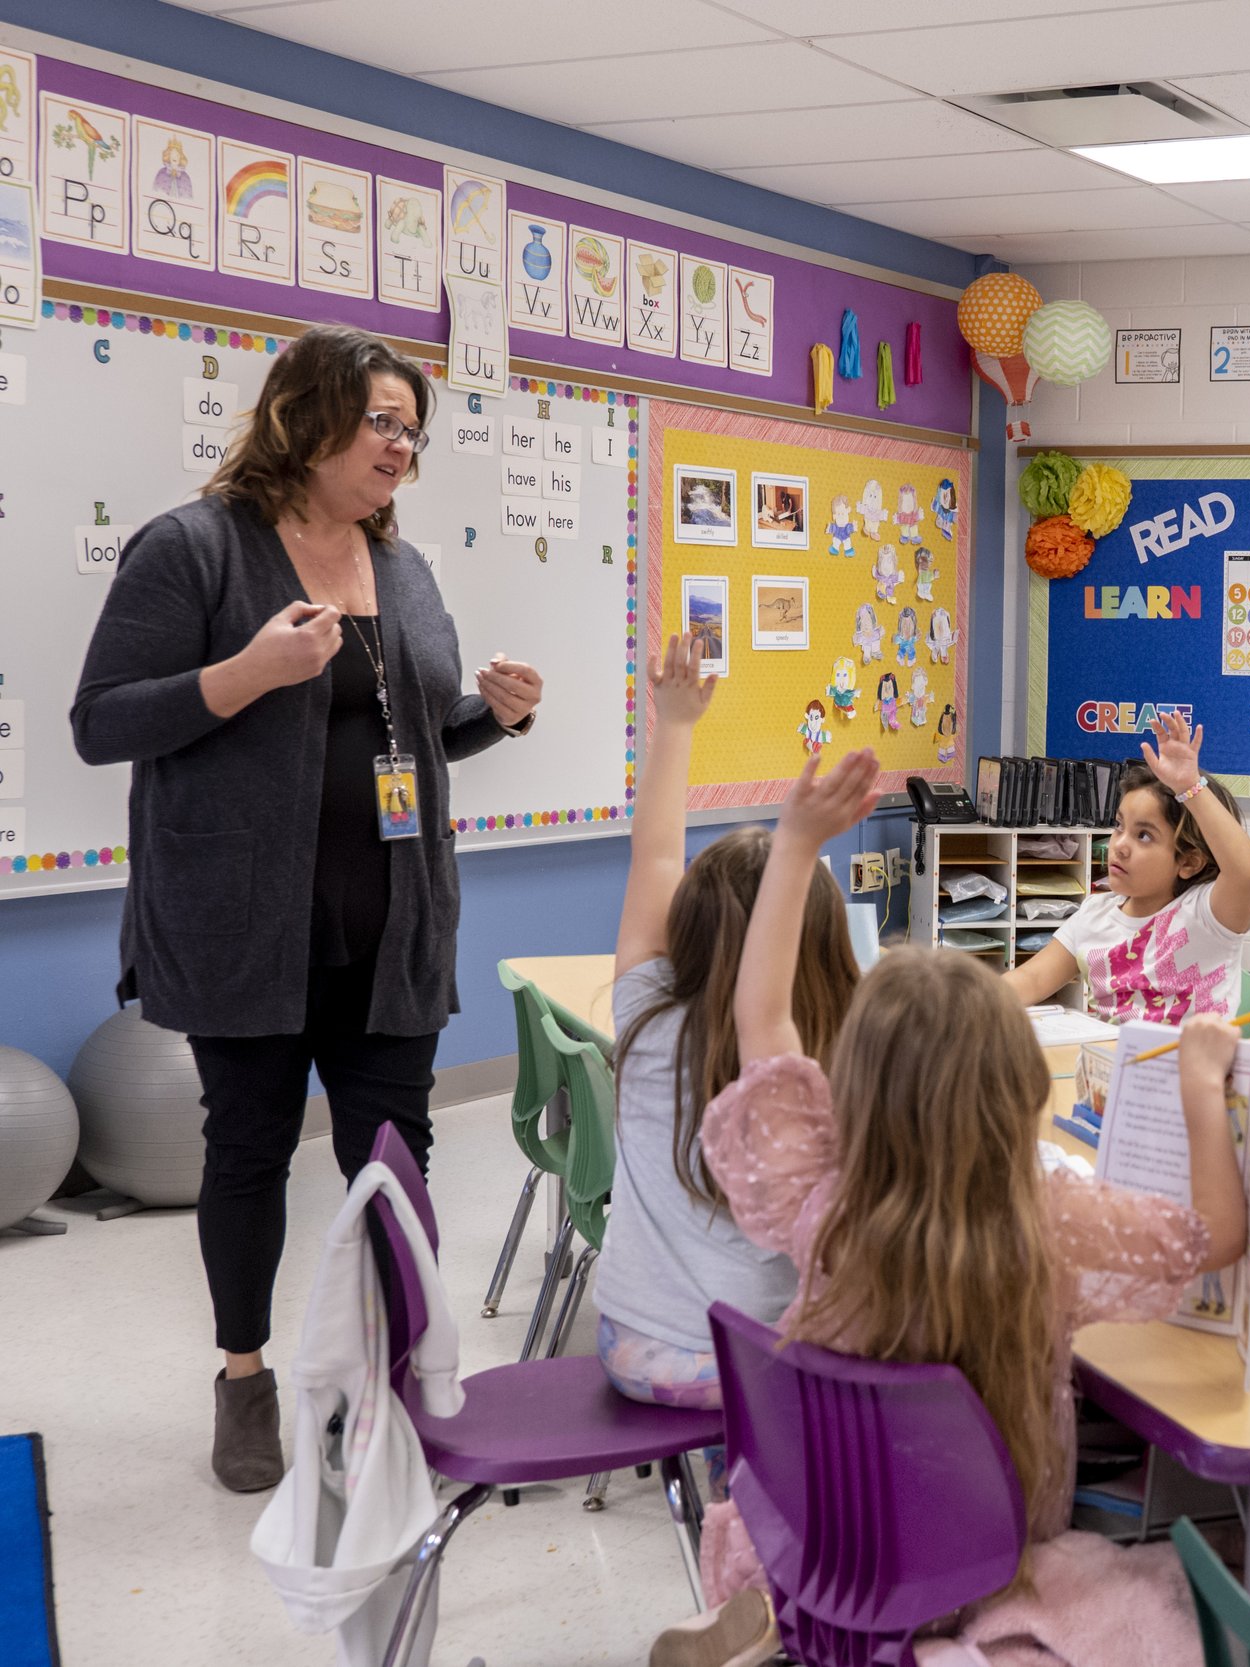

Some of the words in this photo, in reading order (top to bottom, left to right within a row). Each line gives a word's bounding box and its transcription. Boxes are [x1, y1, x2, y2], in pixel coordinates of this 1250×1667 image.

[64, 178, 105, 239] Pp
[147, 199, 200, 259] Qq
[240, 223, 276, 262] Rr
[319, 241, 351, 278] Ss
[459, 242, 489, 278] Uu
[394, 255, 422, 292] Tt
[523, 283, 552, 317] Vv
[574, 294, 619, 331] Ww
[642, 294, 660, 309] box
[638, 308, 663, 341] Xx
[690, 314, 715, 357] Yy
[93, 339, 111, 363] C
[739, 330, 760, 360] Zz
[202, 355, 219, 379] D
[464, 346, 494, 379] Uu
[1213, 346, 1231, 374] 2
[198, 391, 223, 417] do
[467, 393, 482, 414] G
[537, 400, 550, 419] H
[607, 408, 614, 427] I
[457, 425, 489, 445] good
[511, 425, 535, 449] her
[555, 432, 572, 453] he
[607, 438, 613, 456] I
[192, 434, 228, 467] day
[507, 468, 536, 486] have
[552, 471, 572, 492] his
[94, 502, 110, 526] L
[506, 506, 537, 527] how
[548, 511, 573, 529] here
[465, 527, 476, 547] P
[1129, 492, 1235, 564] READ
[85, 537, 121, 562] loo
[535, 537, 548, 562] Q
[602, 545, 613, 564] R
[1084, 585, 1202, 620] LEARN
